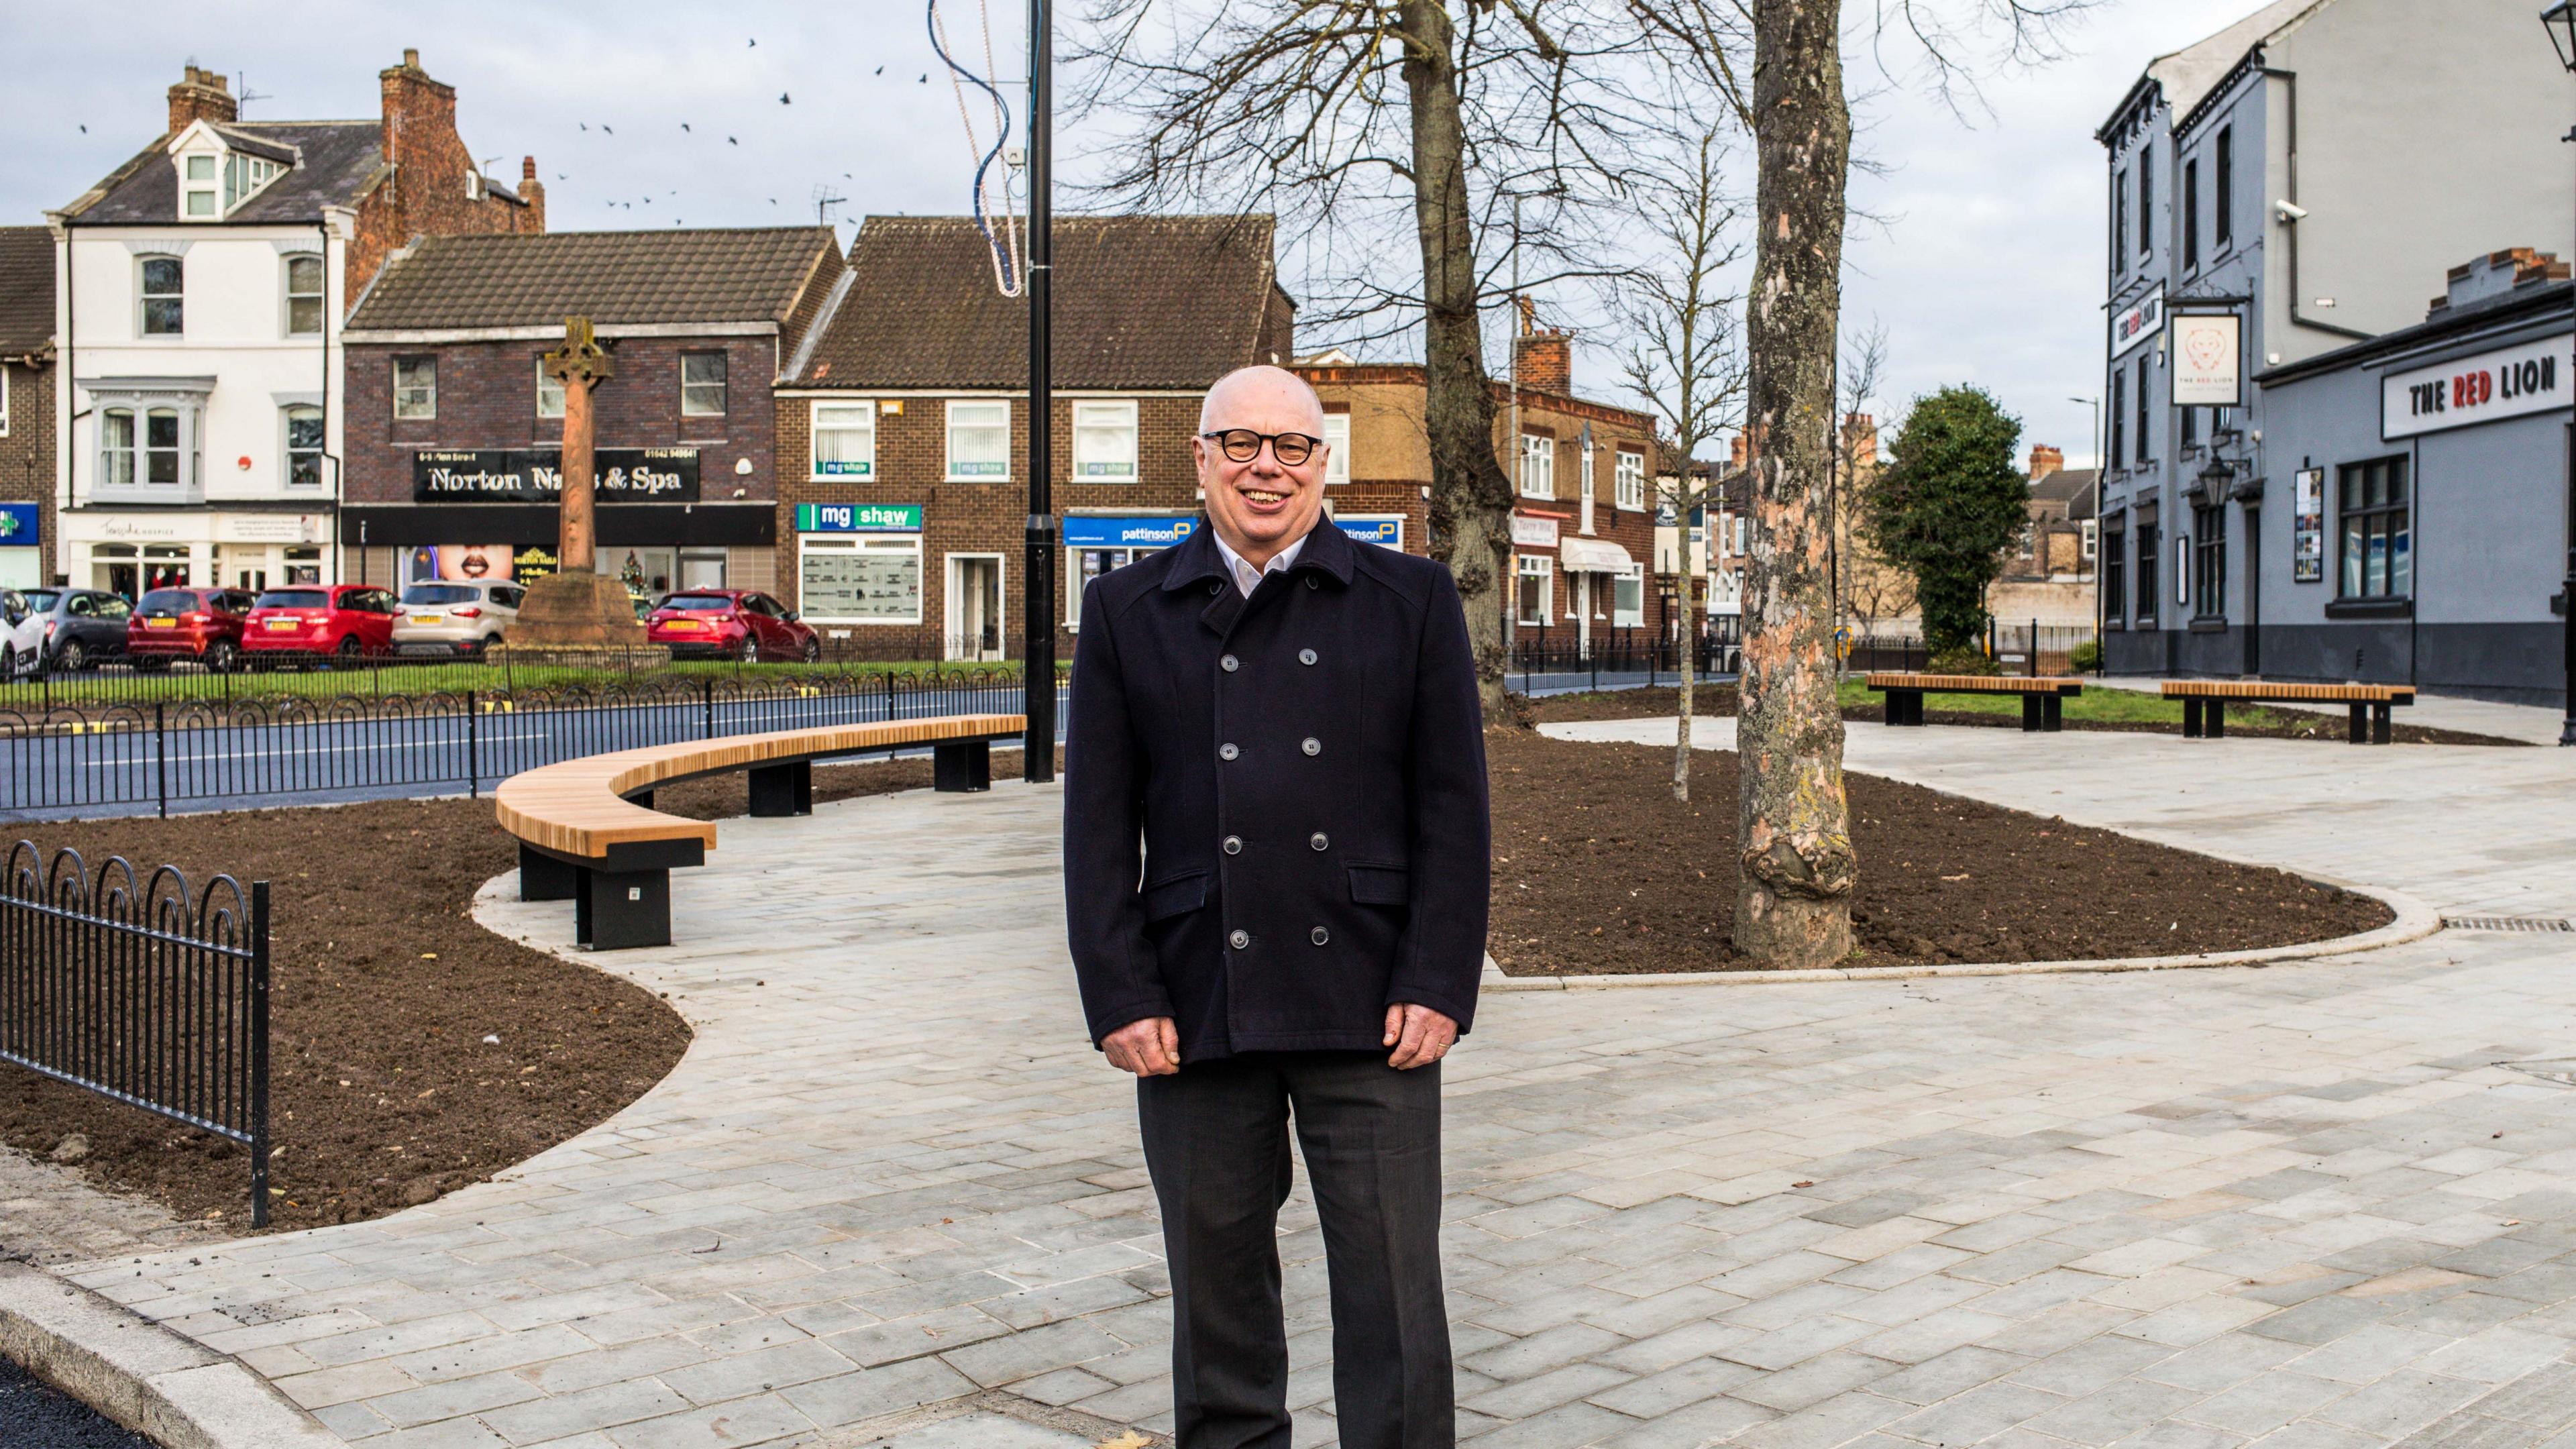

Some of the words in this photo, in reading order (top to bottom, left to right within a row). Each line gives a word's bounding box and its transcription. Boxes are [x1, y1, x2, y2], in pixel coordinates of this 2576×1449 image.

[2410, 380, 2445, 416] THE
[2453, 370, 2492, 408] RED
[2501, 355, 2555, 399] LION
[427, 468, 522, 491] Norton
[604, 467, 627, 490] &
[632, 466, 682, 494] Spa
[821, 507, 850, 527] mg
[861, 506, 908, 523] shaw
[1122, 528, 1173, 541] pattinson
